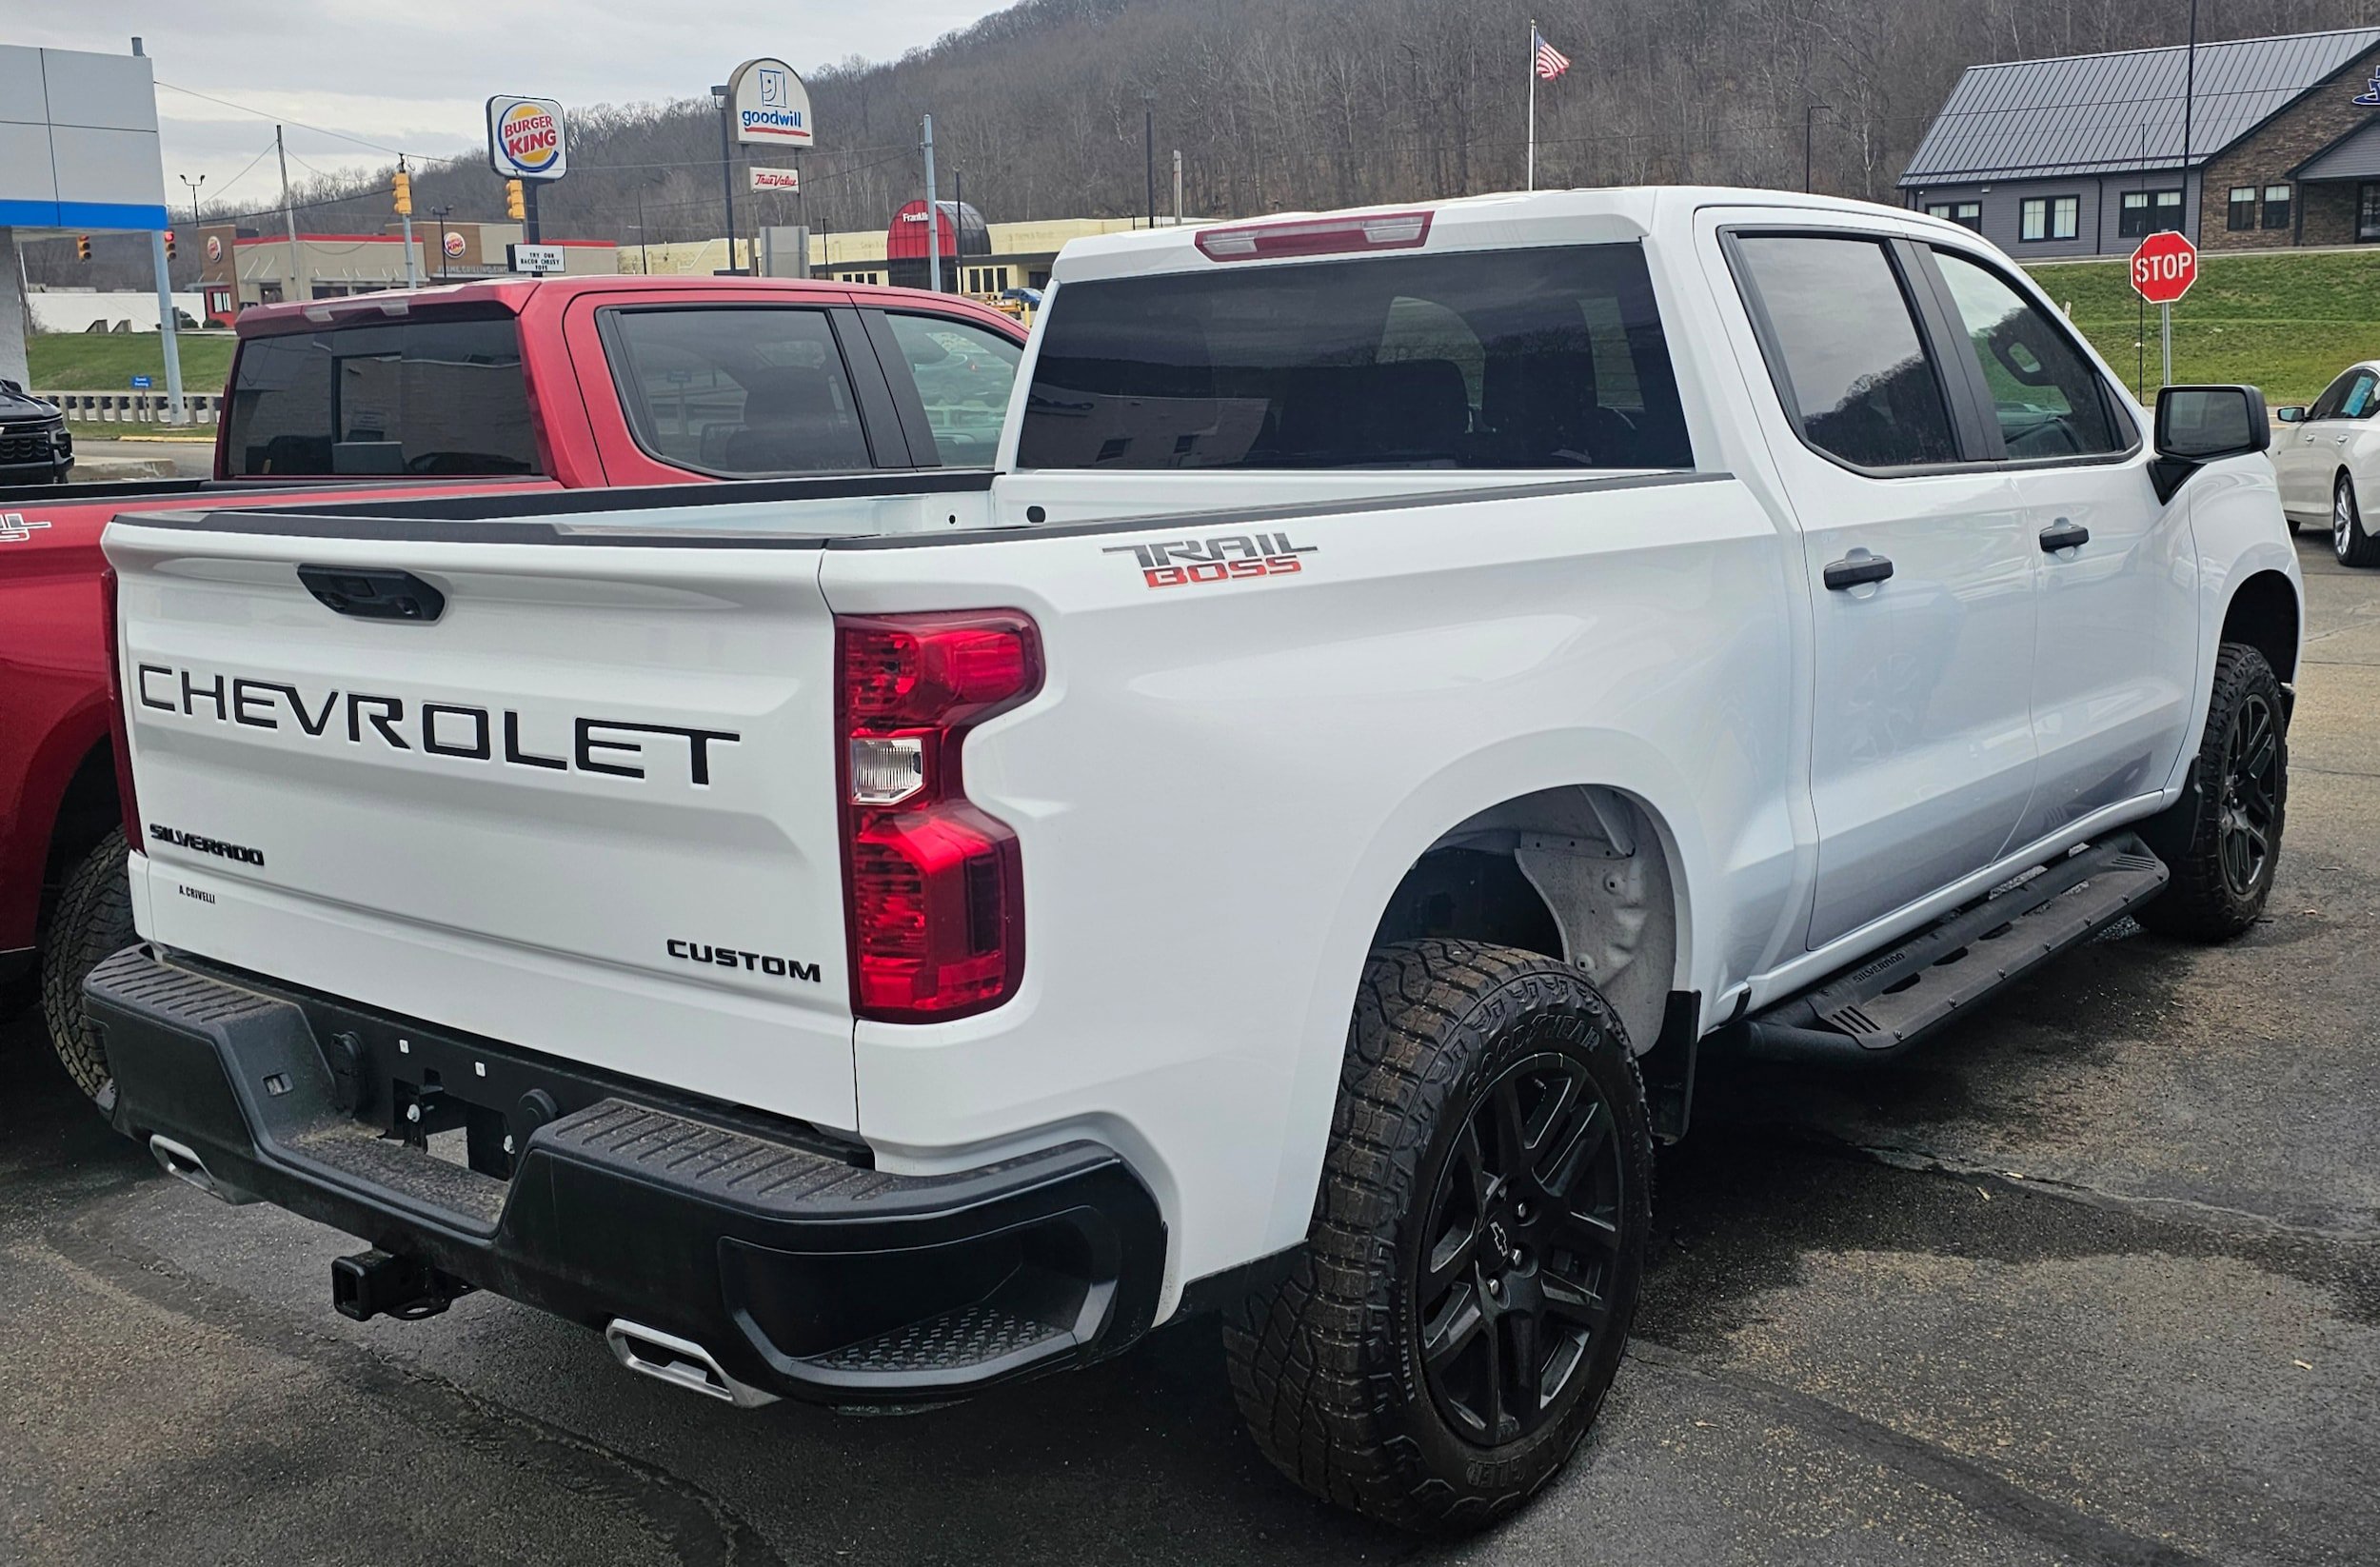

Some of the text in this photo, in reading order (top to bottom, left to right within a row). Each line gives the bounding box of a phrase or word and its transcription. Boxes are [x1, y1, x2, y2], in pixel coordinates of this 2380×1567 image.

[505, 115, 553, 138] BURGER
[742, 110, 802, 128] goodwill
[508, 129, 557, 157] KING
[2135, 251, 2192, 283] STOP
[1101, 532, 1319, 568] TRAIL
[1142, 554, 1302, 588] BOSS
[138, 663, 742, 785] CHEVROLET
[149, 823, 265, 866] SILVERADO
[179, 884, 216, 904] A. CRIVELLI
[666, 939, 822, 982] CUSTOM
[1852, 952, 1906, 983] SILVERADO
